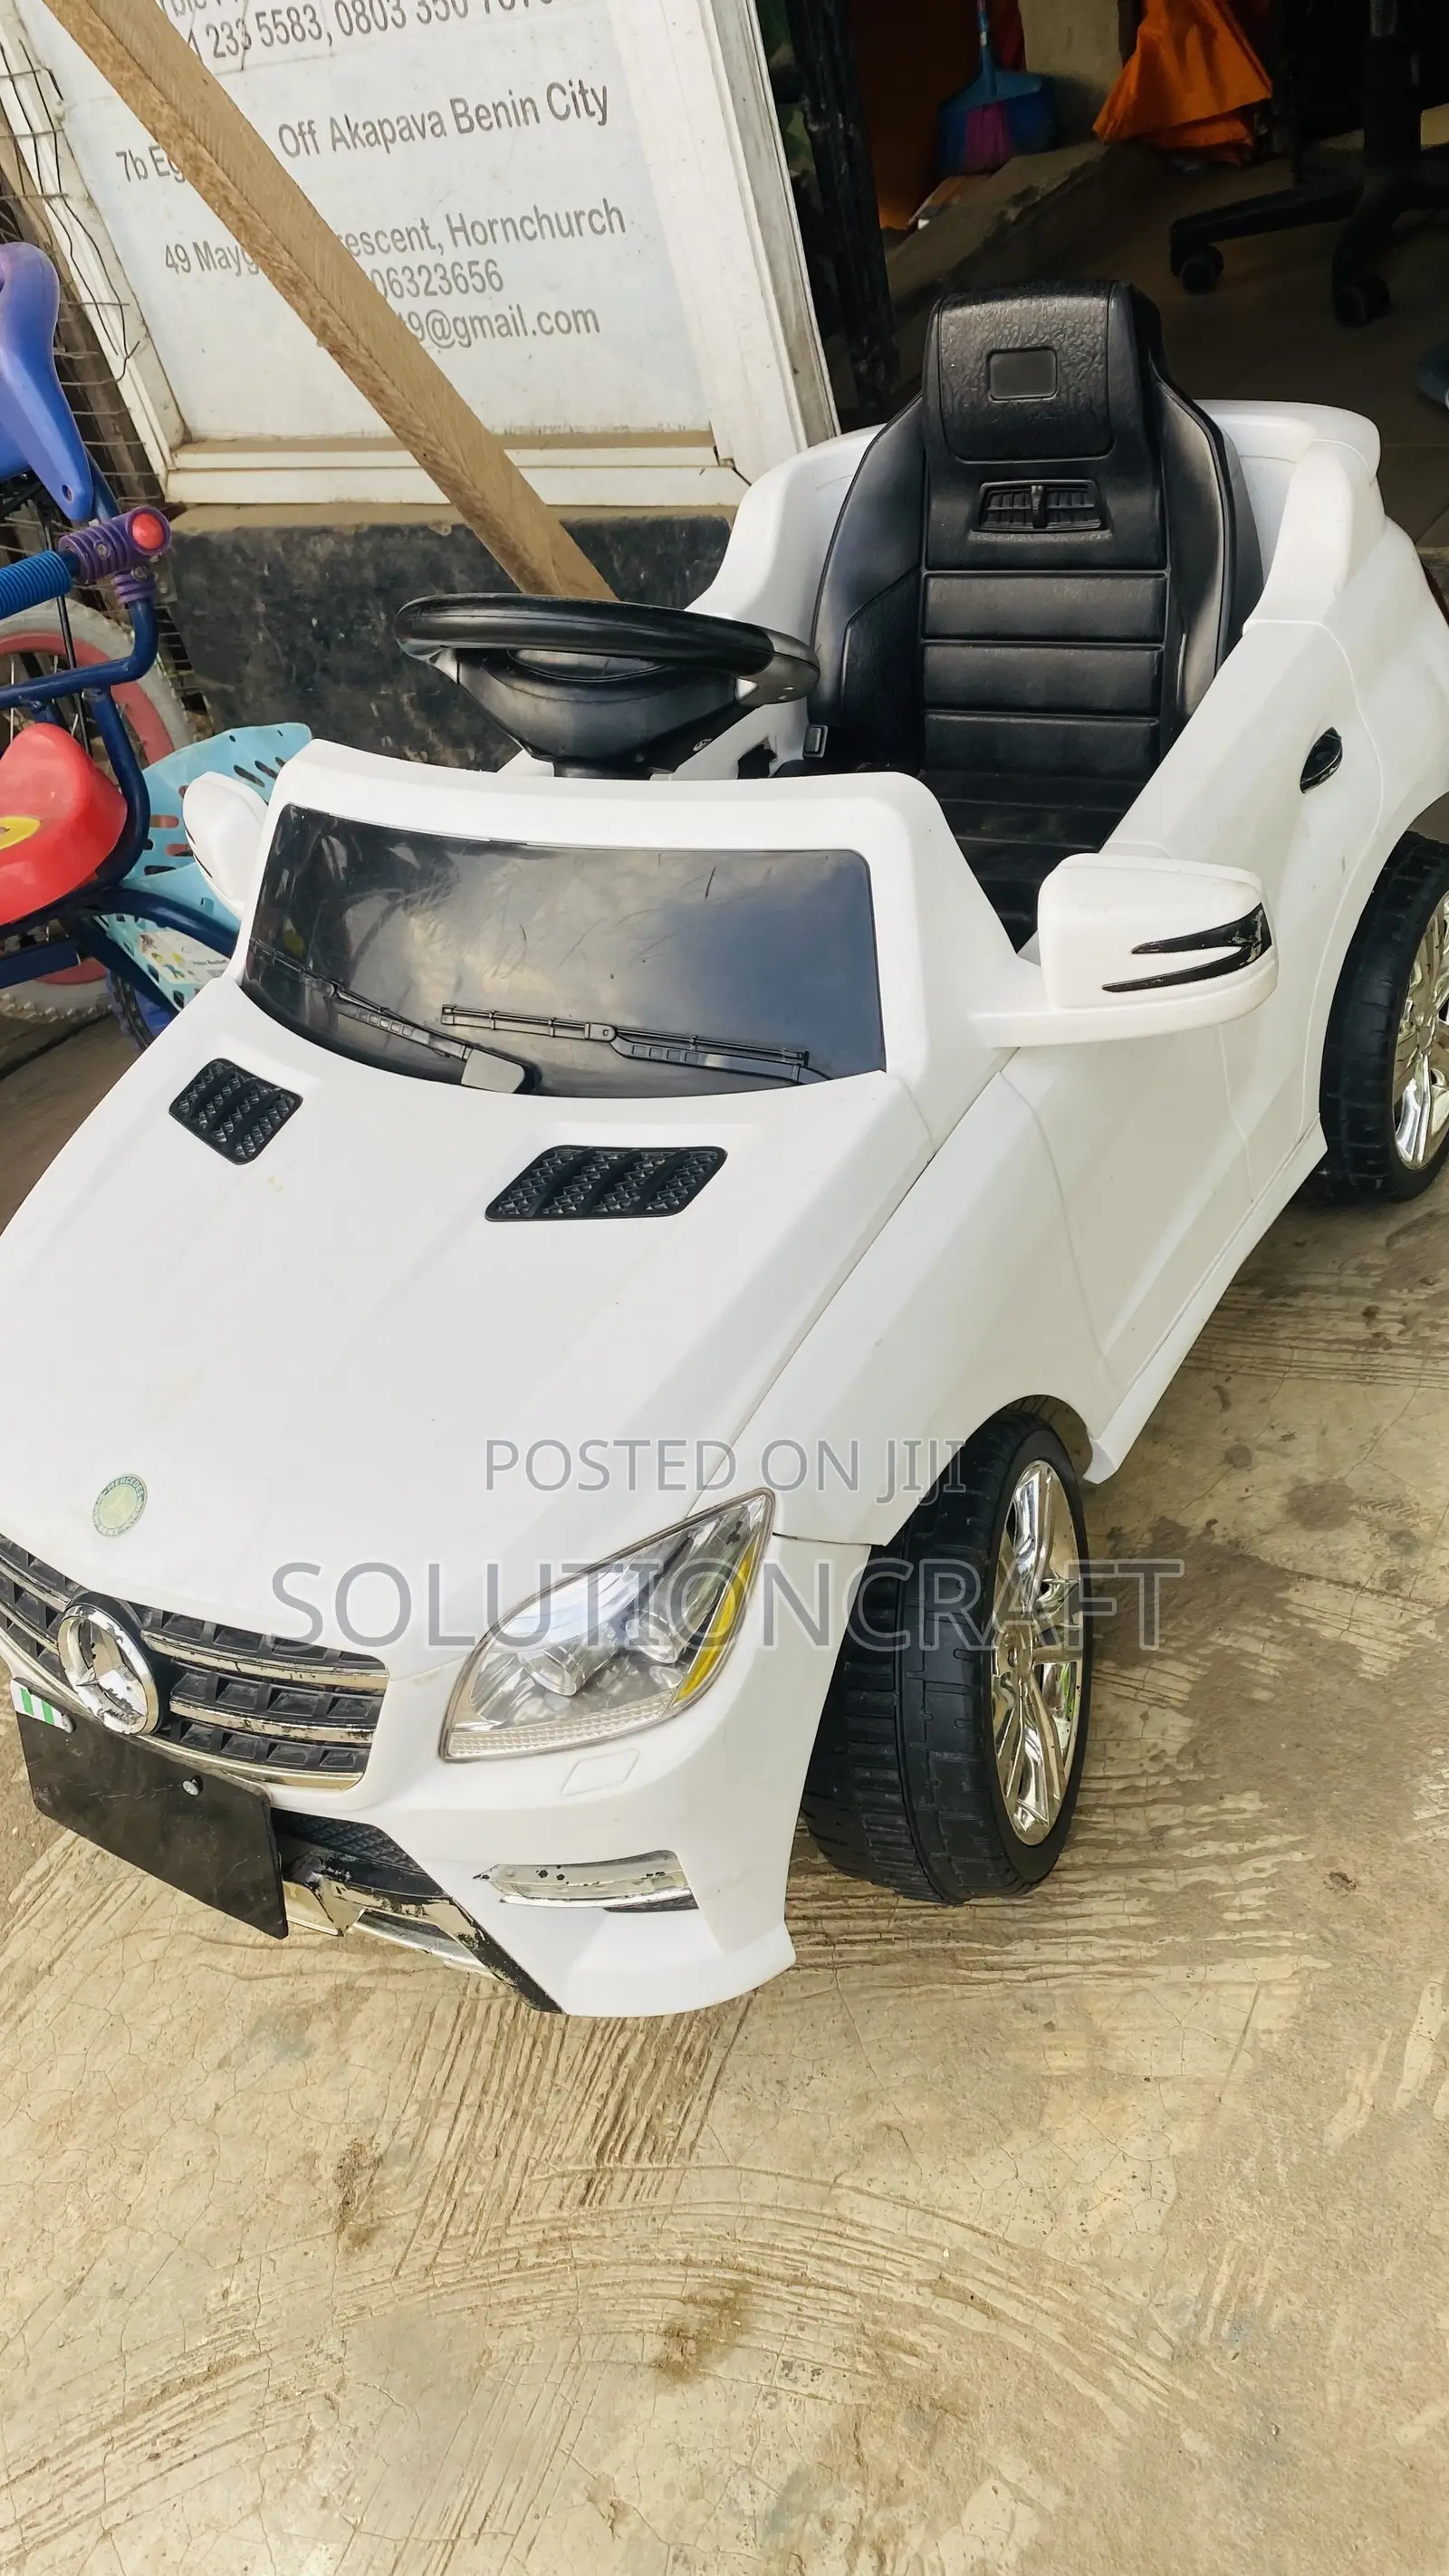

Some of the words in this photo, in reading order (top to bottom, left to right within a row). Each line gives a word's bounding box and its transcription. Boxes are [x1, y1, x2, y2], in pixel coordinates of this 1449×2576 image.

[254, 4, 333, 48] 5583,
[334, 0, 407, 36] 0803
[115, 149, 149, 182] 7b
[278, 120, 321, 158] Off
[329, 113, 448, 155] Akapava
[449, 89, 541, 135] Benin
[546, 78, 609, 127] City
[165, 243, 192, 274] 49
[446, 197, 627, 249] Hornchurch
